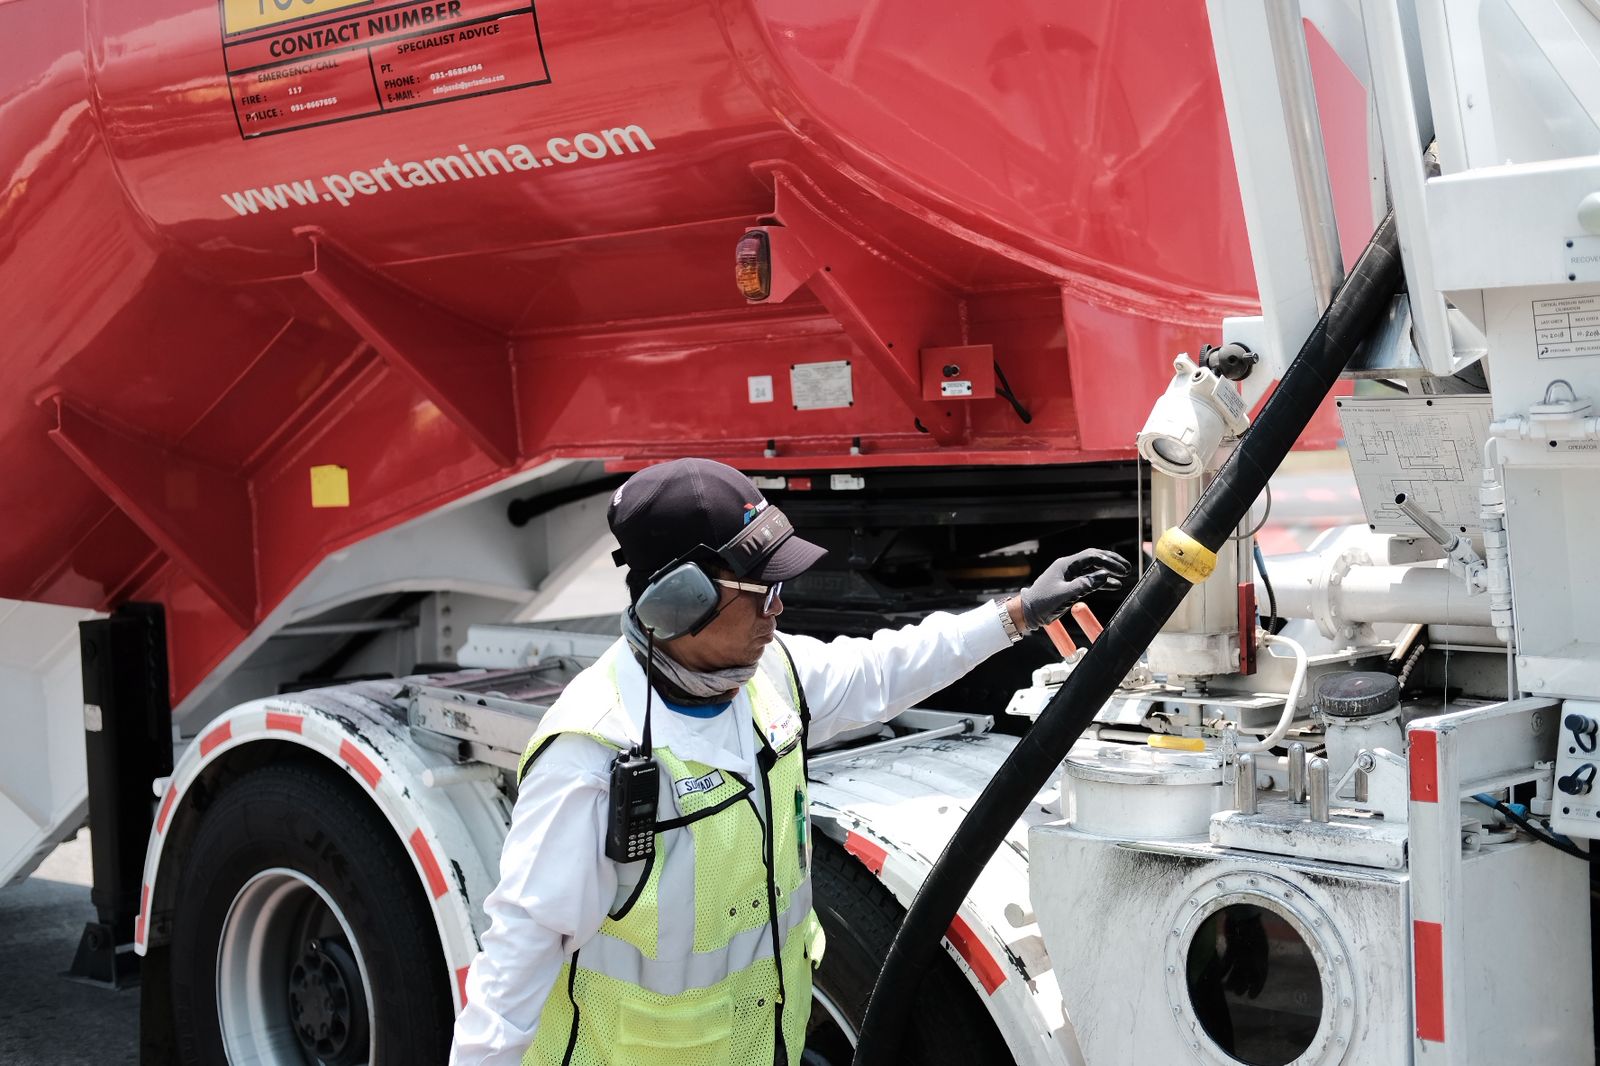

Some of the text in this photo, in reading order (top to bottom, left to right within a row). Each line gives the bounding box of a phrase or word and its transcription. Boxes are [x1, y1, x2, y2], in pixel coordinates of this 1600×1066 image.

[270, 1, 462, 57] CONTACT NUMBER
[397, 24, 500, 54] SPECIALIST ADVICE
[257, 59, 339, 83] EMERGENCY CALL
[380, 64, 394, 74] PT.
[384, 75, 415, 89] PHONE
[241, 94, 262, 105] FIRE
[387, 89, 415, 103] E-MAIL
[245, 108, 279, 122] POLICE
[221, 123, 656, 216] www.pertamina.com
[1570, 255, 1600, 264] RECOVE
